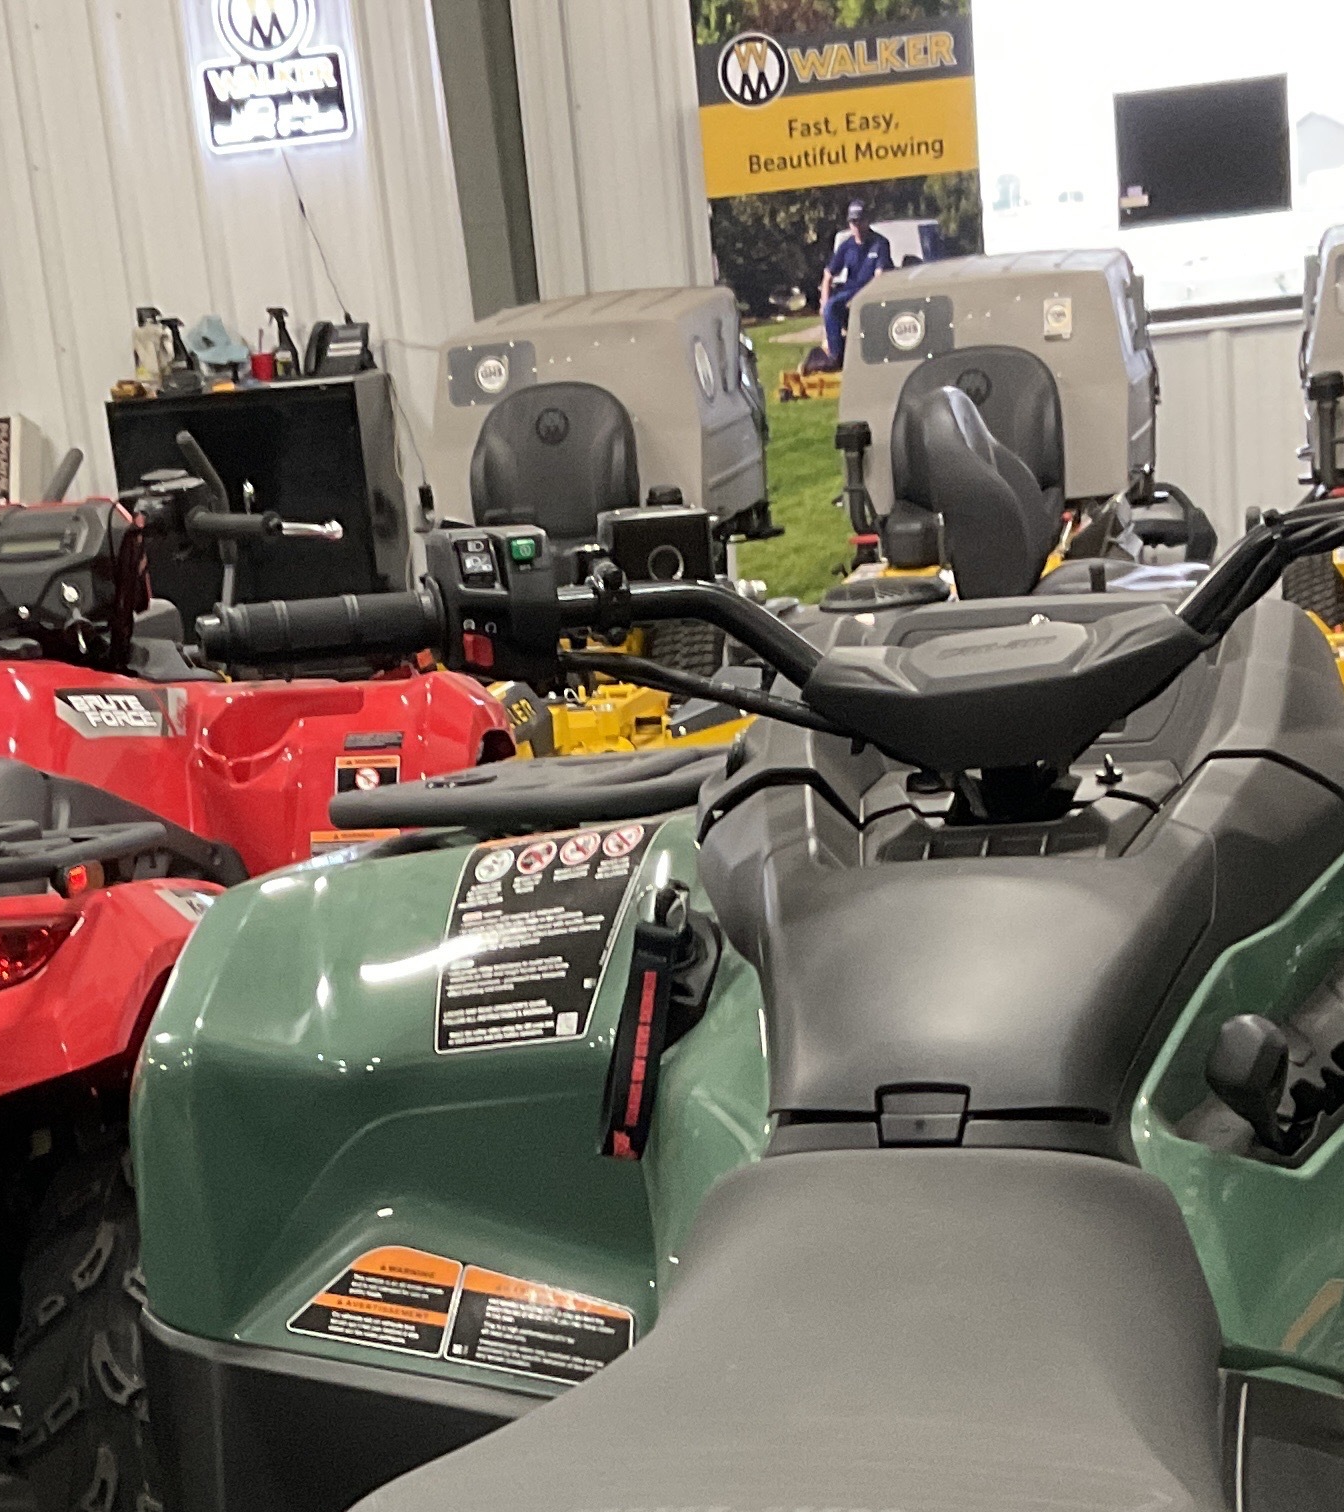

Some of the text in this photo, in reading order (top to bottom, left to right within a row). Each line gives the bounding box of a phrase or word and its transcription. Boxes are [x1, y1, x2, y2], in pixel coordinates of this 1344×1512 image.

[787, 31, 958, 83] WALKER
[788, 111, 900, 139] Fast, Easy,
[748, 135, 945, 174] Beautiful Mowing
[67, 694, 145, 713] BRUTE
[83, 710, 157, 728] FORCE
